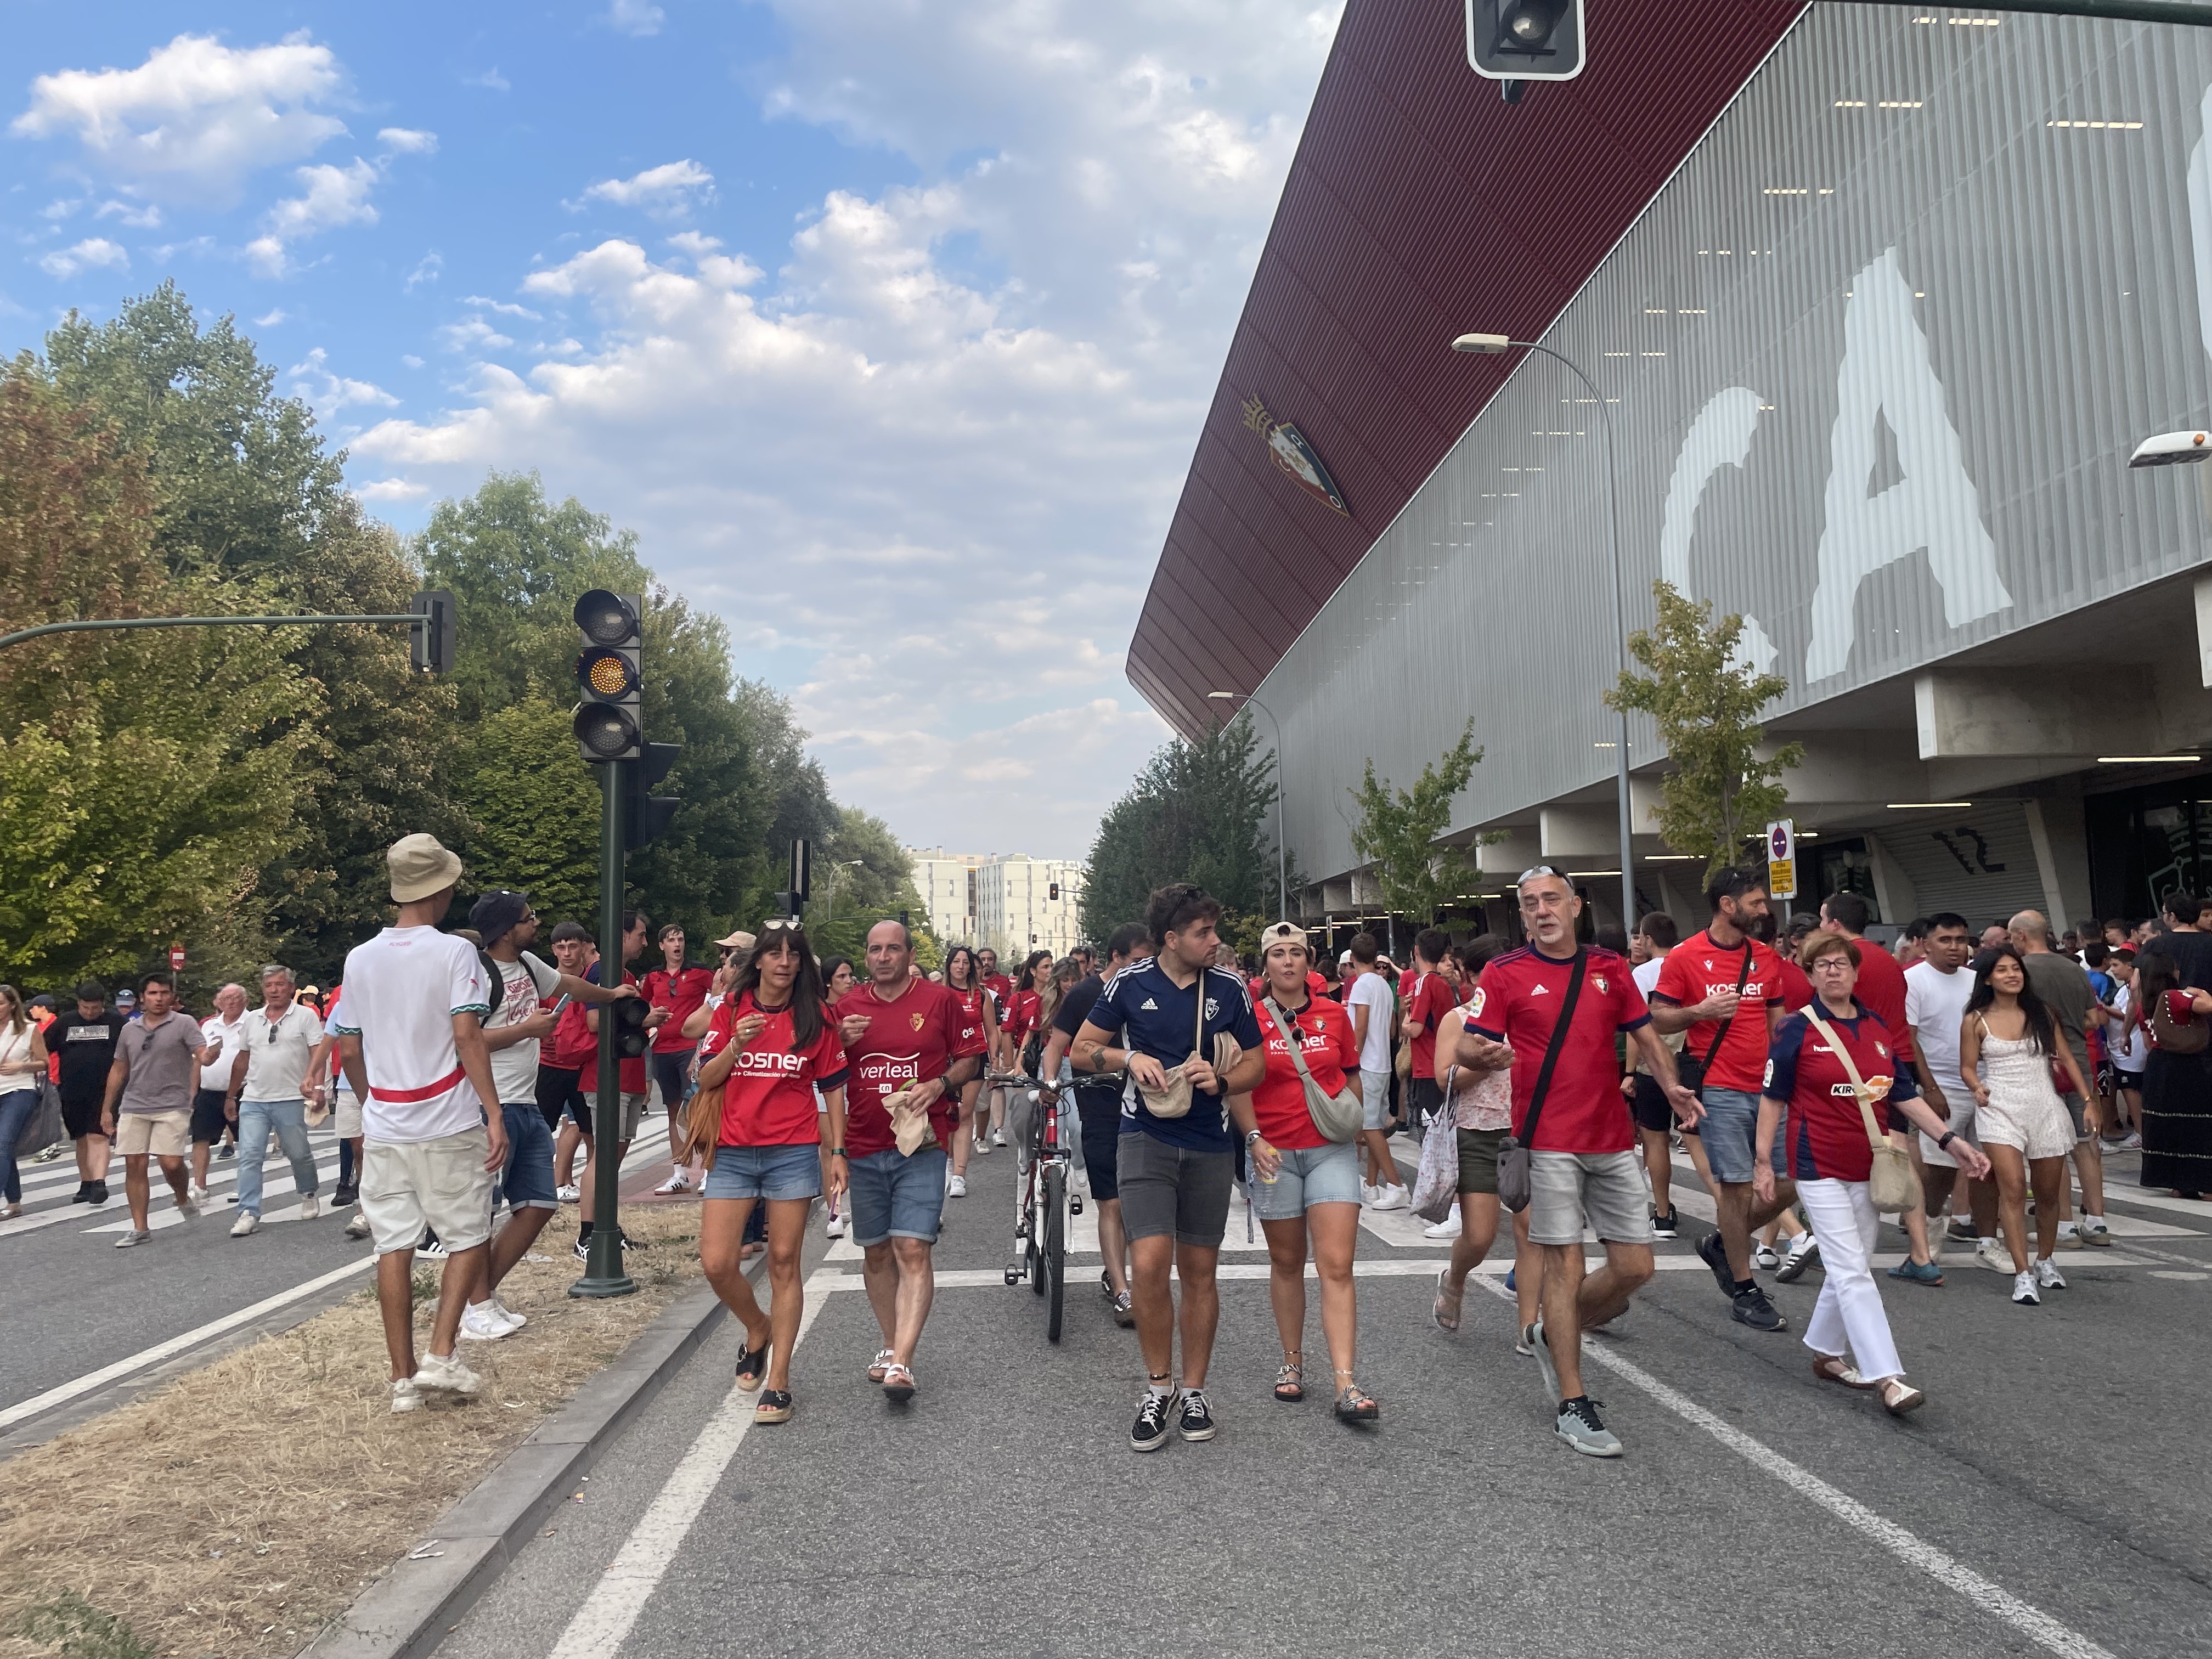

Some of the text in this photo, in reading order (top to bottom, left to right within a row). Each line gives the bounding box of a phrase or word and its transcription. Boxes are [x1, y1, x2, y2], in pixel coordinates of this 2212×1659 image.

[1932, 827, 2006, 874] 12
[1269, 1035, 1327, 1050] koner
[859, 1061, 919, 1079] verleal
